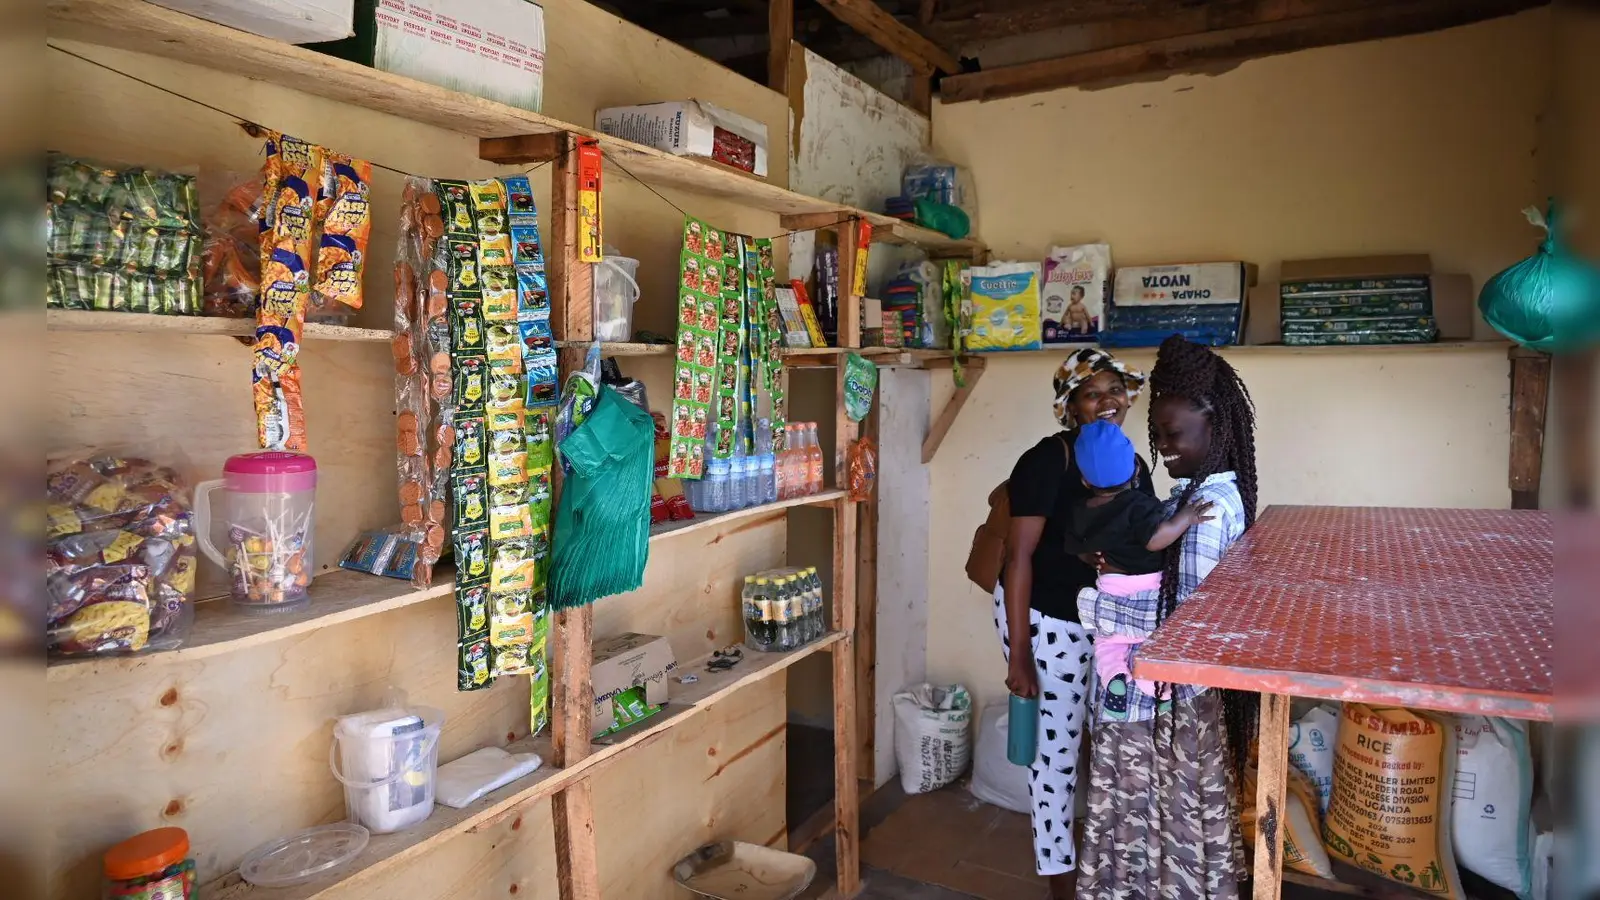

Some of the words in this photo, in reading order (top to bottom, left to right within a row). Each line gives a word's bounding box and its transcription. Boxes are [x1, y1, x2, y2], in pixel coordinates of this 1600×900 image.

[1142, 275, 1190, 288] NYOTA
[1172, 288, 1211, 300] CHAPA
[1368, 714, 1436, 736] SIMBA
[1357, 733, 1393, 755] RICE
[1347, 762, 1363, 777] RICE
[1365, 771, 1398, 785] MILLER
[1400, 776, 1436, 786] LIMITED
[1359, 786, 1390, 804] MASESE
[1393, 794, 1430, 804] DIVISION
[1375, 784, 1398, 795] EDEN
[1400, 786, 1424, 795] ROAD
[1364, 798, 1411, 814] UGANDA
[1396, 836, 1416, 844] 2024
